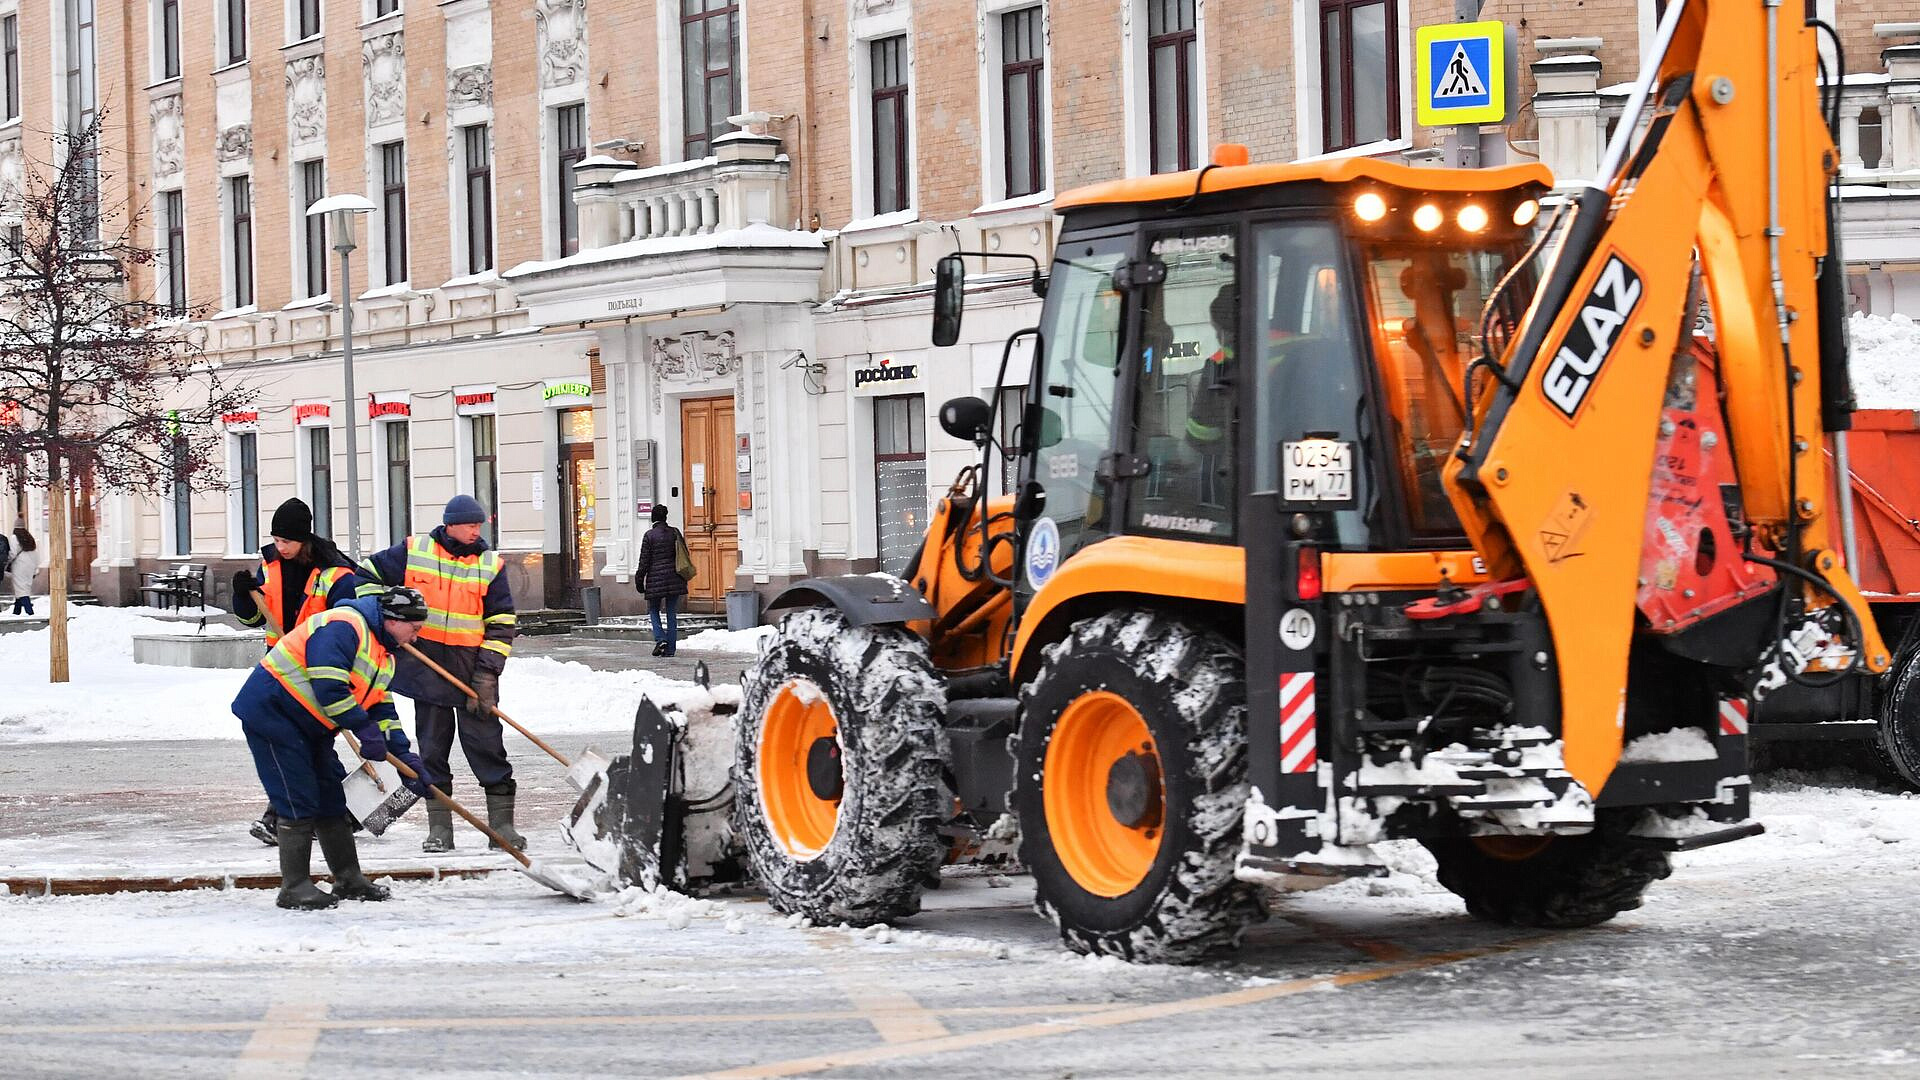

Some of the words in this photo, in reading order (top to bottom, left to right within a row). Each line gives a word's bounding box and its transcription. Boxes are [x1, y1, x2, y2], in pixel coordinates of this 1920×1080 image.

[1543, 257, 1642, 414] ELAZ
[855, 359, 918, 388] росбанк
[1292, 445, 1342, 468] 0254
[1327, 473, 1345, 490] 77
[1285, 616, 1311, 639] 40
